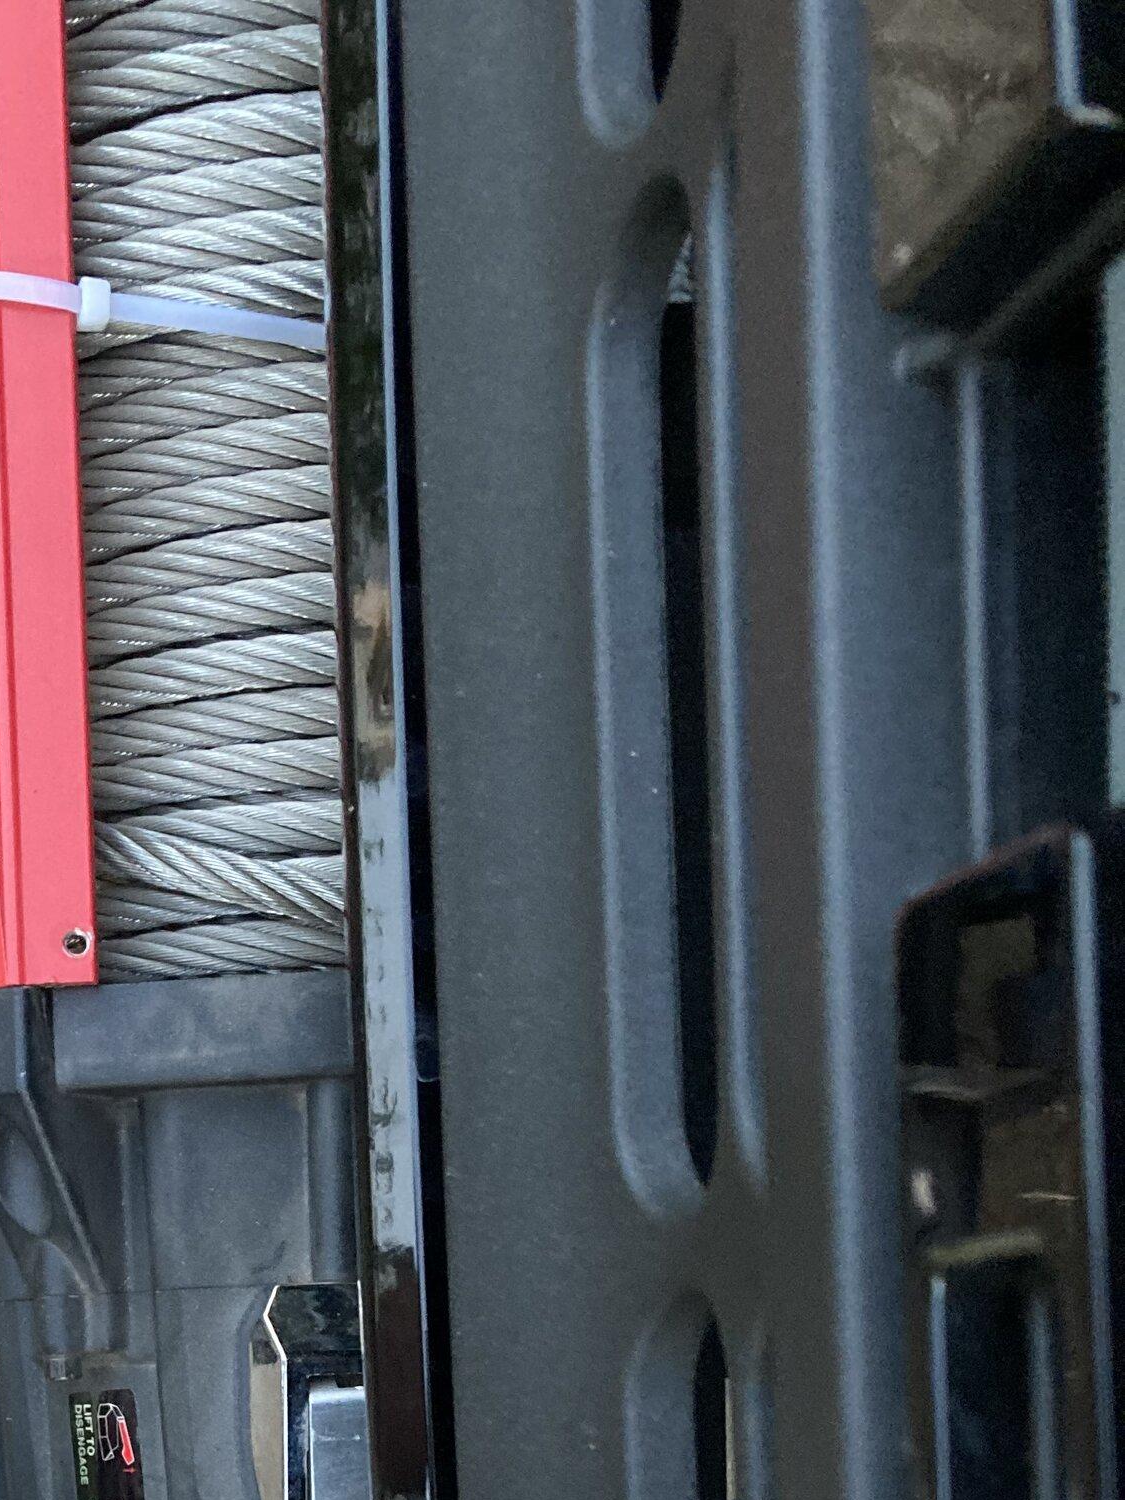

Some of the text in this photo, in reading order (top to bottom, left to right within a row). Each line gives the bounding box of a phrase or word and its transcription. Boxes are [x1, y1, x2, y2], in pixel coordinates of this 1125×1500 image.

[74, 1403, 89, 1486] DISENGAGE
[83, 1403, 96, 1457] LIFT TO
